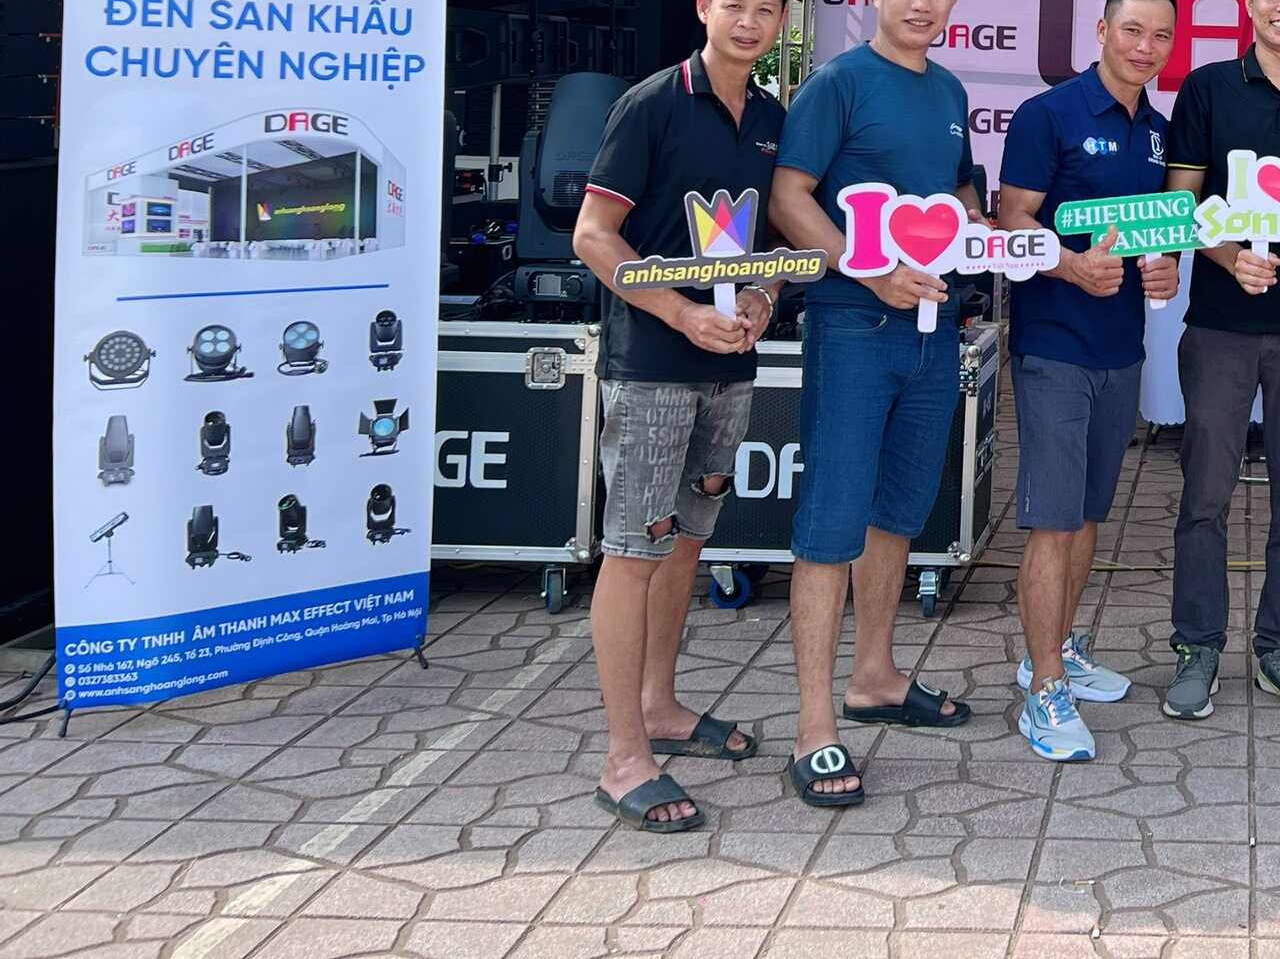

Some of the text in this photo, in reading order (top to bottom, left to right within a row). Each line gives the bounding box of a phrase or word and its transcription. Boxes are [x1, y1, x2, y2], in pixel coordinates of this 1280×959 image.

[84, 42, 426, 90] CHUYÊN NGHIỆP
[264, 112, 349, 136] DAGE
[168, 132, 215, 161] DAGE
[845, 191, 1045, 271] I DAGE
[1061, 197, 1190, 228] #HIEUUNG
[622, 256, 821, 284] anhsanghoanglong
[435, 431, 509, 489] GE
[65, 589, 414, 656] CÔNG TY TNHH ÂM THANH MAX EFFECT VIỆT NAM
